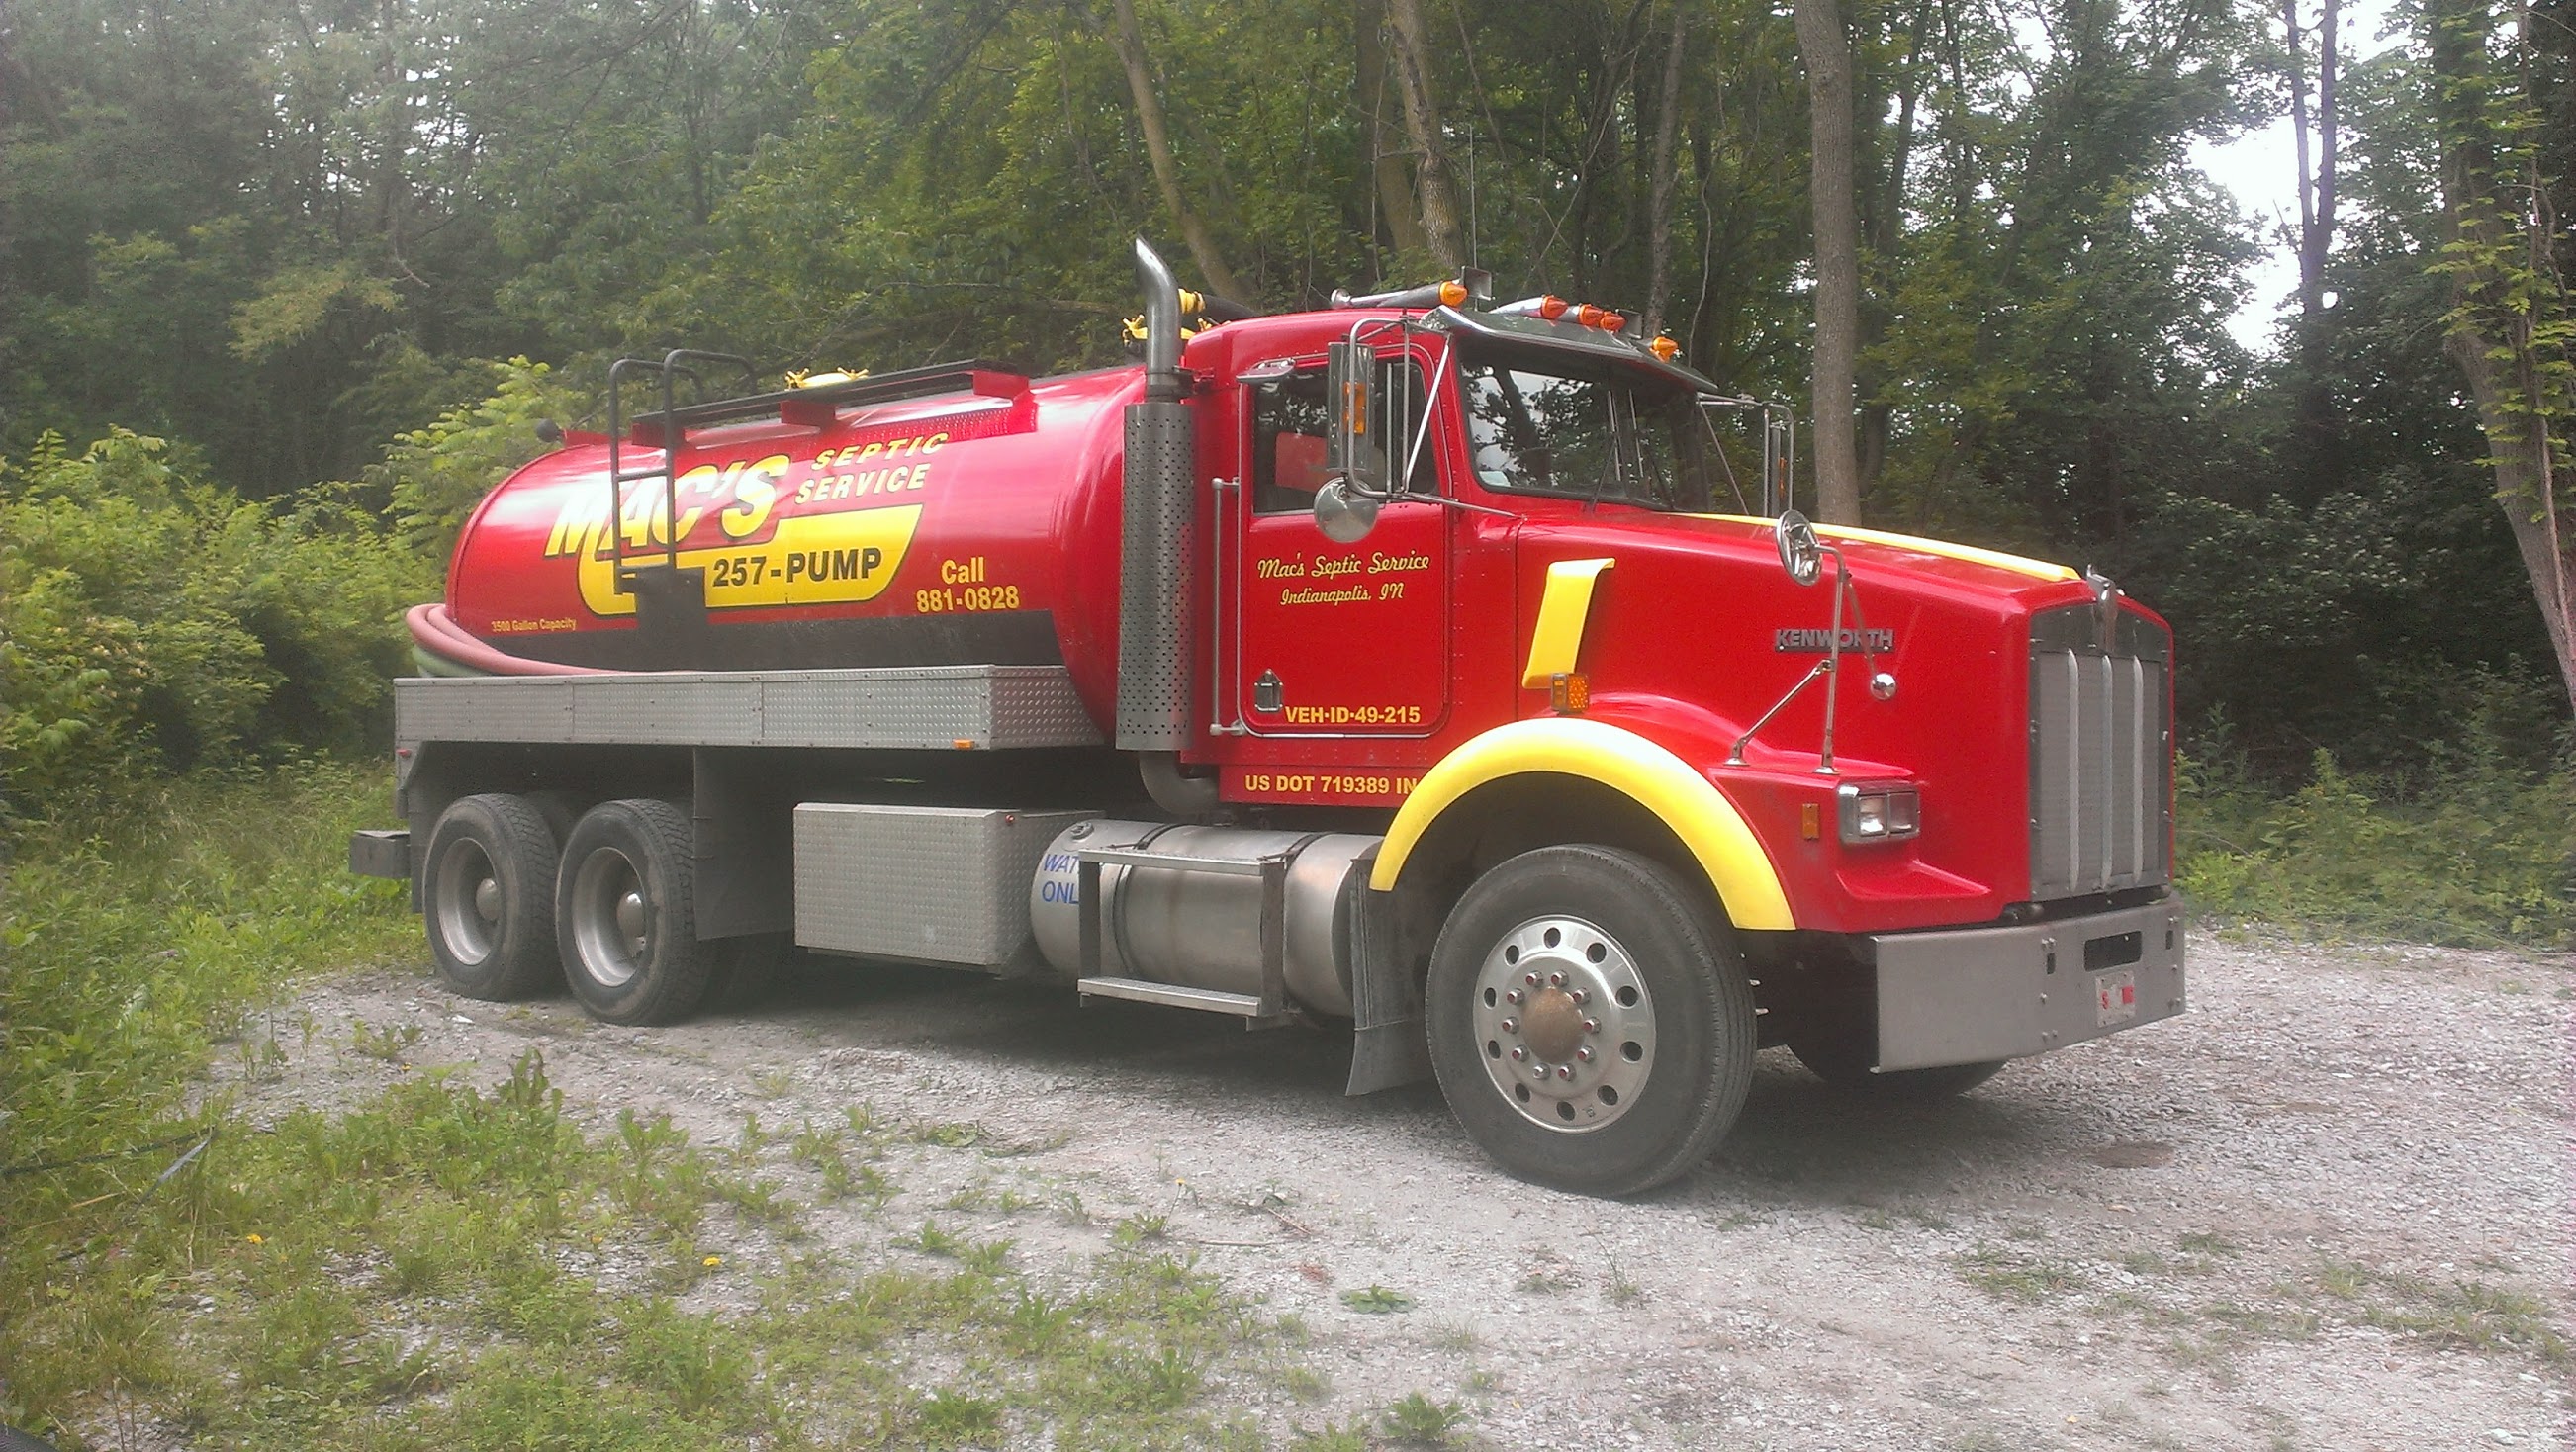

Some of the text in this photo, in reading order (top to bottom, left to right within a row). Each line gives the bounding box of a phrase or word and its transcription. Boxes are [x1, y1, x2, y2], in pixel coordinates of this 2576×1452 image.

[810, 432, 950, 471] SEPTIC
[794, 463, 932, 505] SERVICE
[544, 454, 791, 558] MAC'S
[941, 556, 985, 585] Call
[1257, 550, 1430, 580] Mac's Septic Service
[1379, 582, 1405, 600] IN
[512, 620, 539, 631] Gallon
[539, 617, 577, 631] Capacity
[1245, 775, 1270, 791] US
[1276, 776, 1315, 792] DOT
[1321, 776, 1390, 794] 719389
[1044, 854, 1079, 874] WAT
[1042, 881, 1079, 904] ONL
